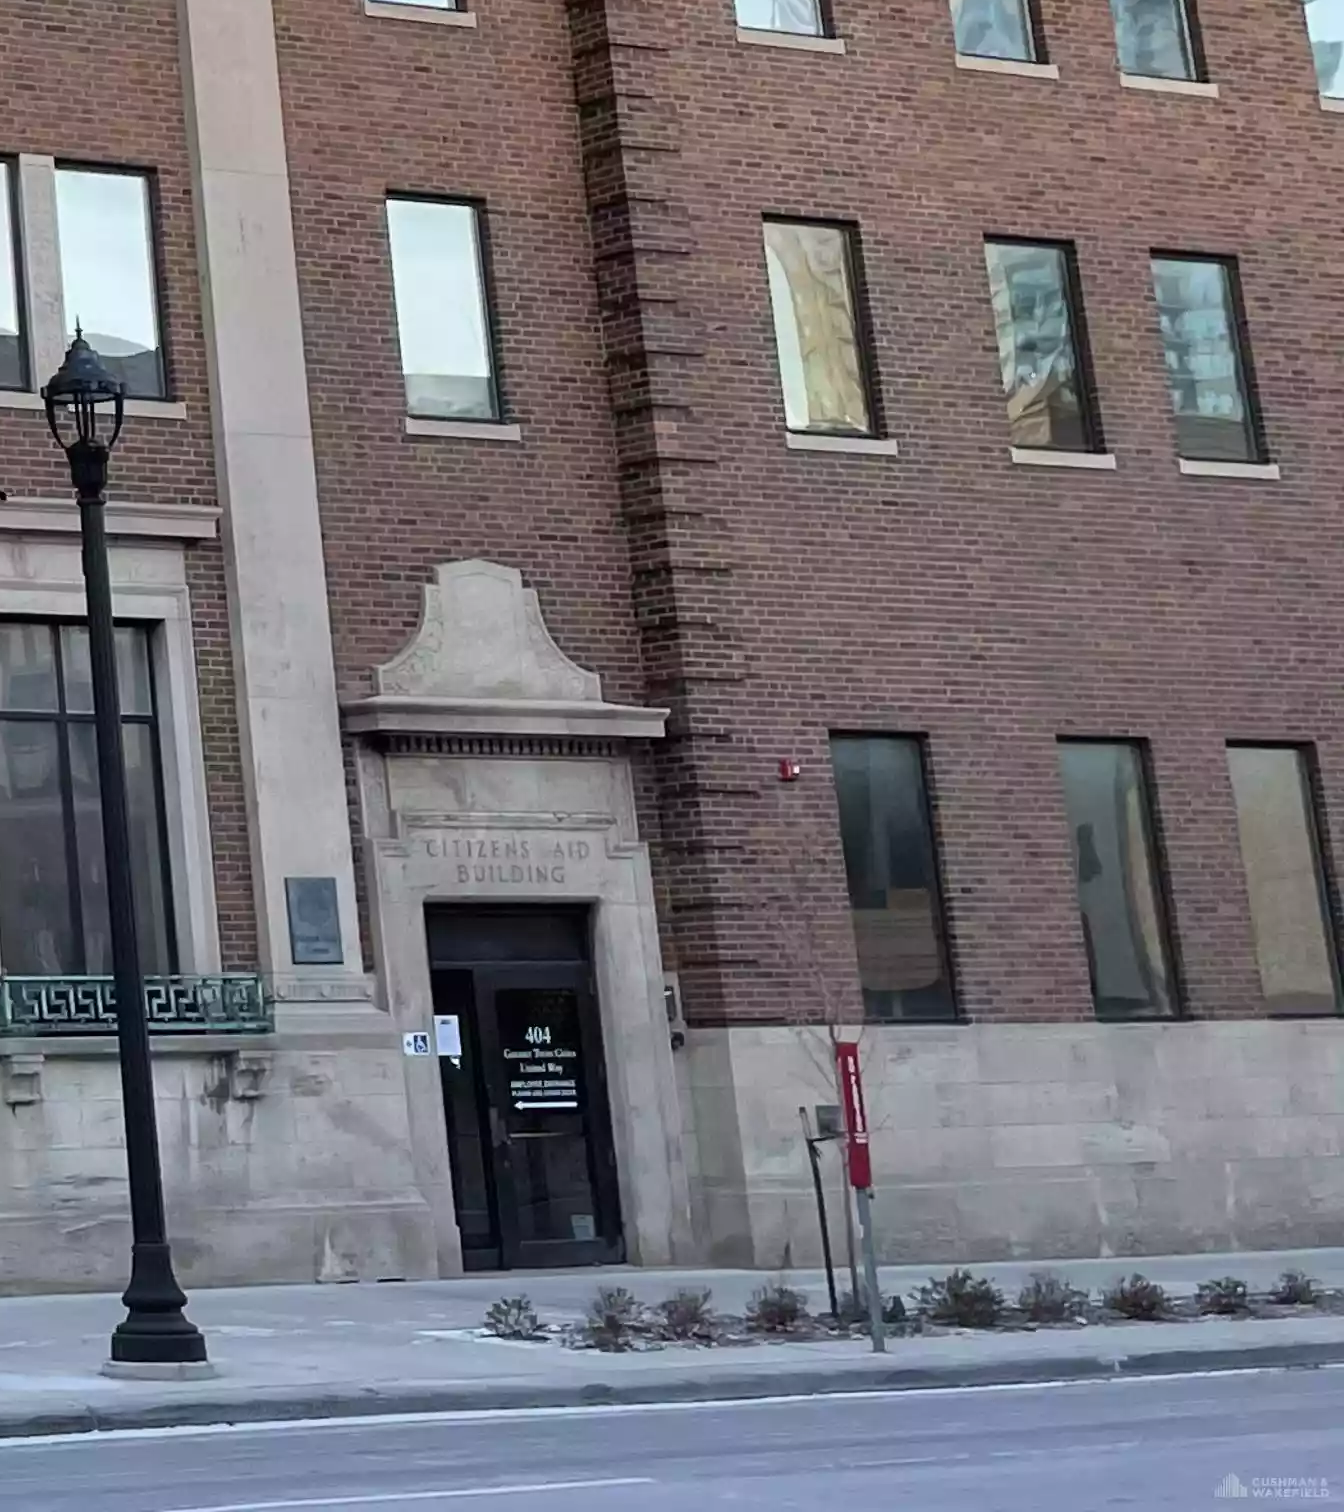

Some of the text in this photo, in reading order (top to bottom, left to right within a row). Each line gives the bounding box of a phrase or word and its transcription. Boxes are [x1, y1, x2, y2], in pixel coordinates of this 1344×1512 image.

[424, 839, 590, 859] CITIZENS AID
[456, 863, 566, 885] BUILDING
[524, 1026, 552, 1045] 404
